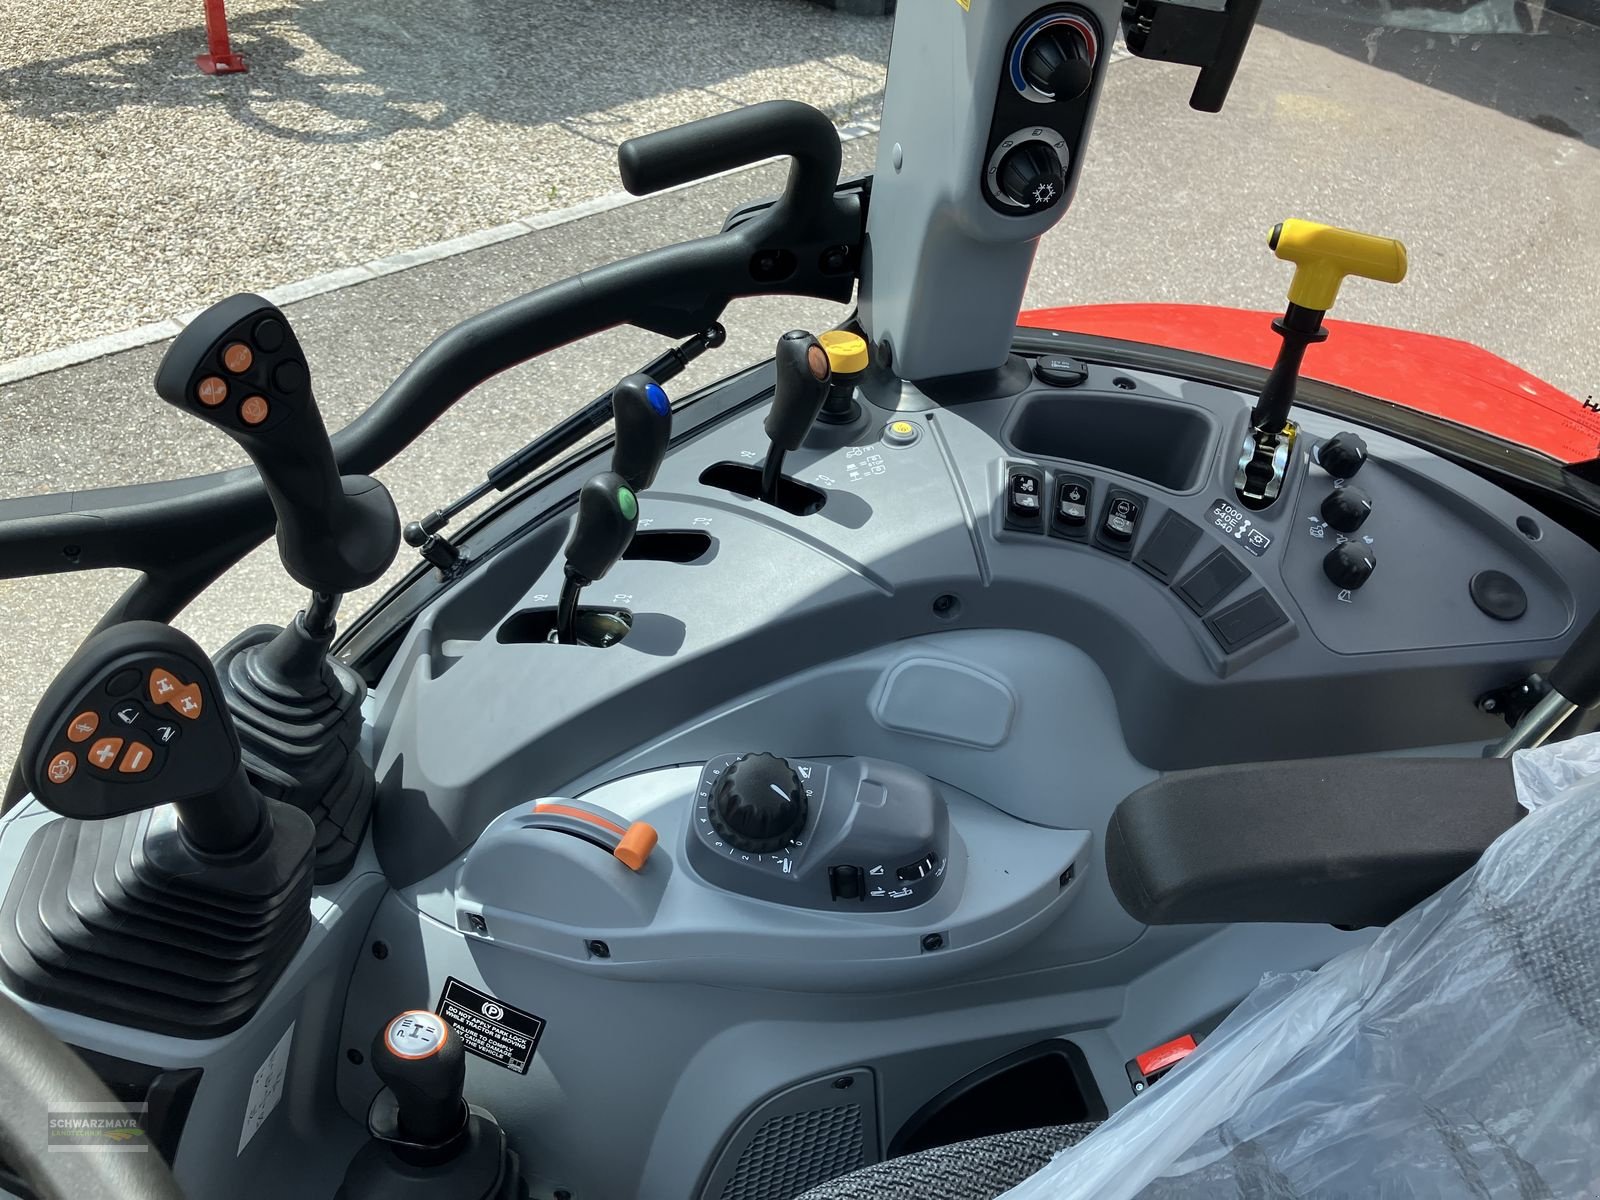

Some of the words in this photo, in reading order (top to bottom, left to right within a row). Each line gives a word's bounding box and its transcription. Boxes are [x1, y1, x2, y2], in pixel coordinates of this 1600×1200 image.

[1214, 508, 1239, 528] 540E
[1221, 503, 1243, 521] 1000
[1214, 518, 1233, 533] 540
[445, 1009, 465, 1023] WHILE
[464, 1019, 495, 1038] TRACTOR
[494, 1032, 502, 1040] IS
[501, 1035, 526, 1050] MOVING
[448, 1006, 458, 1014] DO
[459, 1010, 472, 1020] NOT
[472, 1015, 492, 1030] APPLY
[491, 1024, 508, 1038] PARK
[508, 1033, 527, 1045] LOCK
[452, 1022, 478, 1038] FAILURE
[478, 1034, 488, 1042] TO
[488, 1037, 514, 1053] COMPLY
[464, 1033, 486, 1046] CAUSE
[485, 1042, 513, 1058] DAMAGE
[465, 1039, 478, 1048] THE
[478, 1045, 504, 1059] VEHICLE
